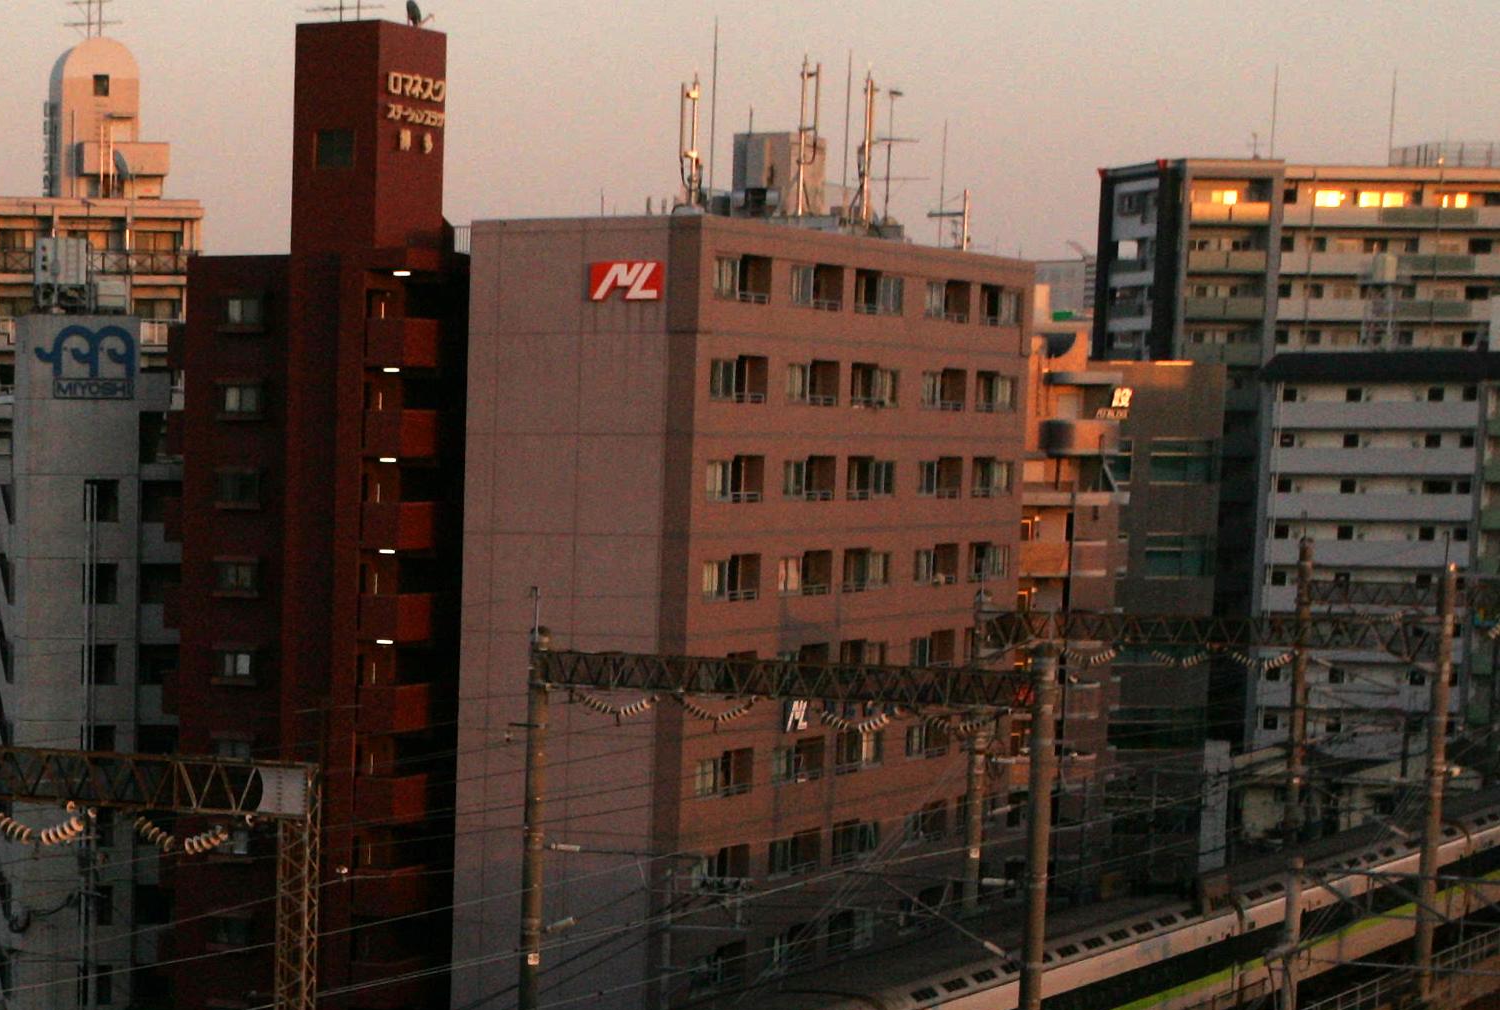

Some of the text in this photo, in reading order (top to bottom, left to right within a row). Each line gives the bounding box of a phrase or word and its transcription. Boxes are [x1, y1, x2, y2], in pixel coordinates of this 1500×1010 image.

[387, 71, 445, 103] ロマネスク
[57, 382, 132, 397] MIYOSHI
